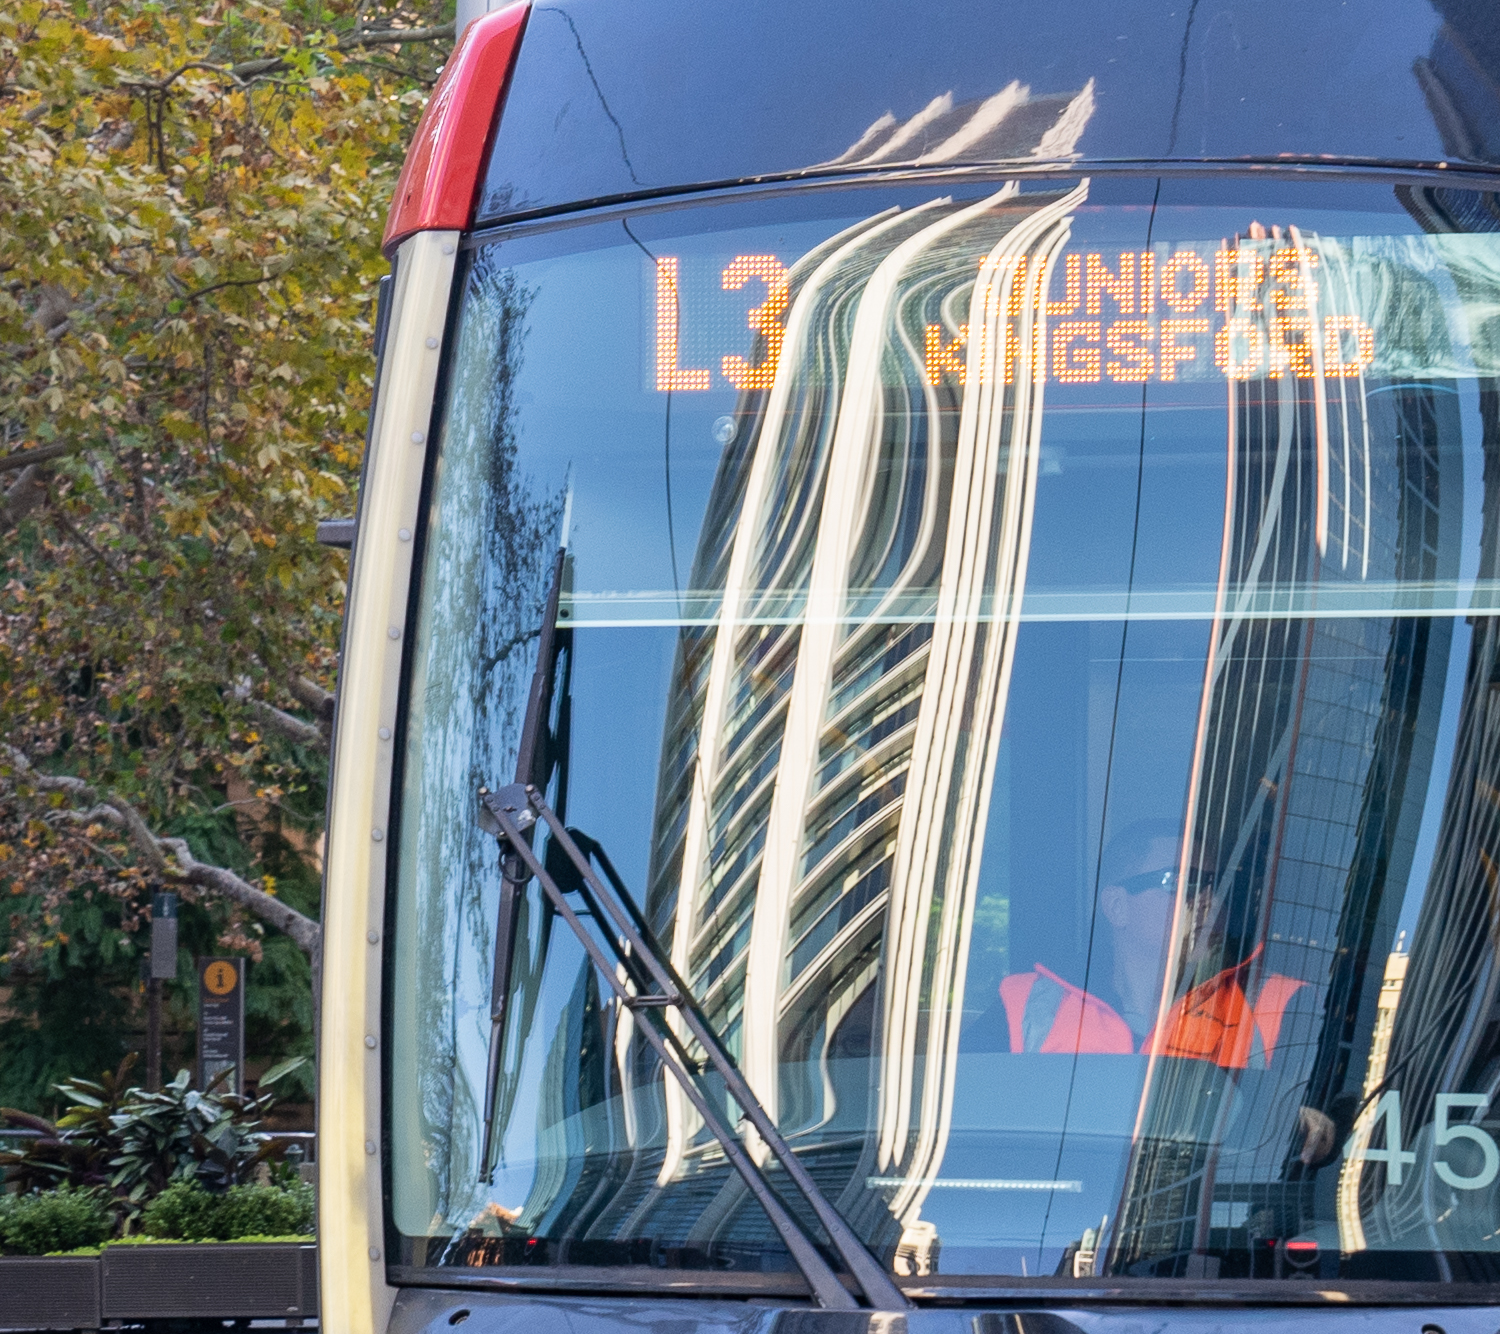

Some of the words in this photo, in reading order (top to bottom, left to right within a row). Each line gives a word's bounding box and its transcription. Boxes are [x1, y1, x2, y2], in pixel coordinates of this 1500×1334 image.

[654, 255, 789, 390] L3
[979, 247, 1319, 317] JUNIORS
[924, 315, 1374, 386] KINGSFORD
[1342, 1089, 1500, 1190] 45
